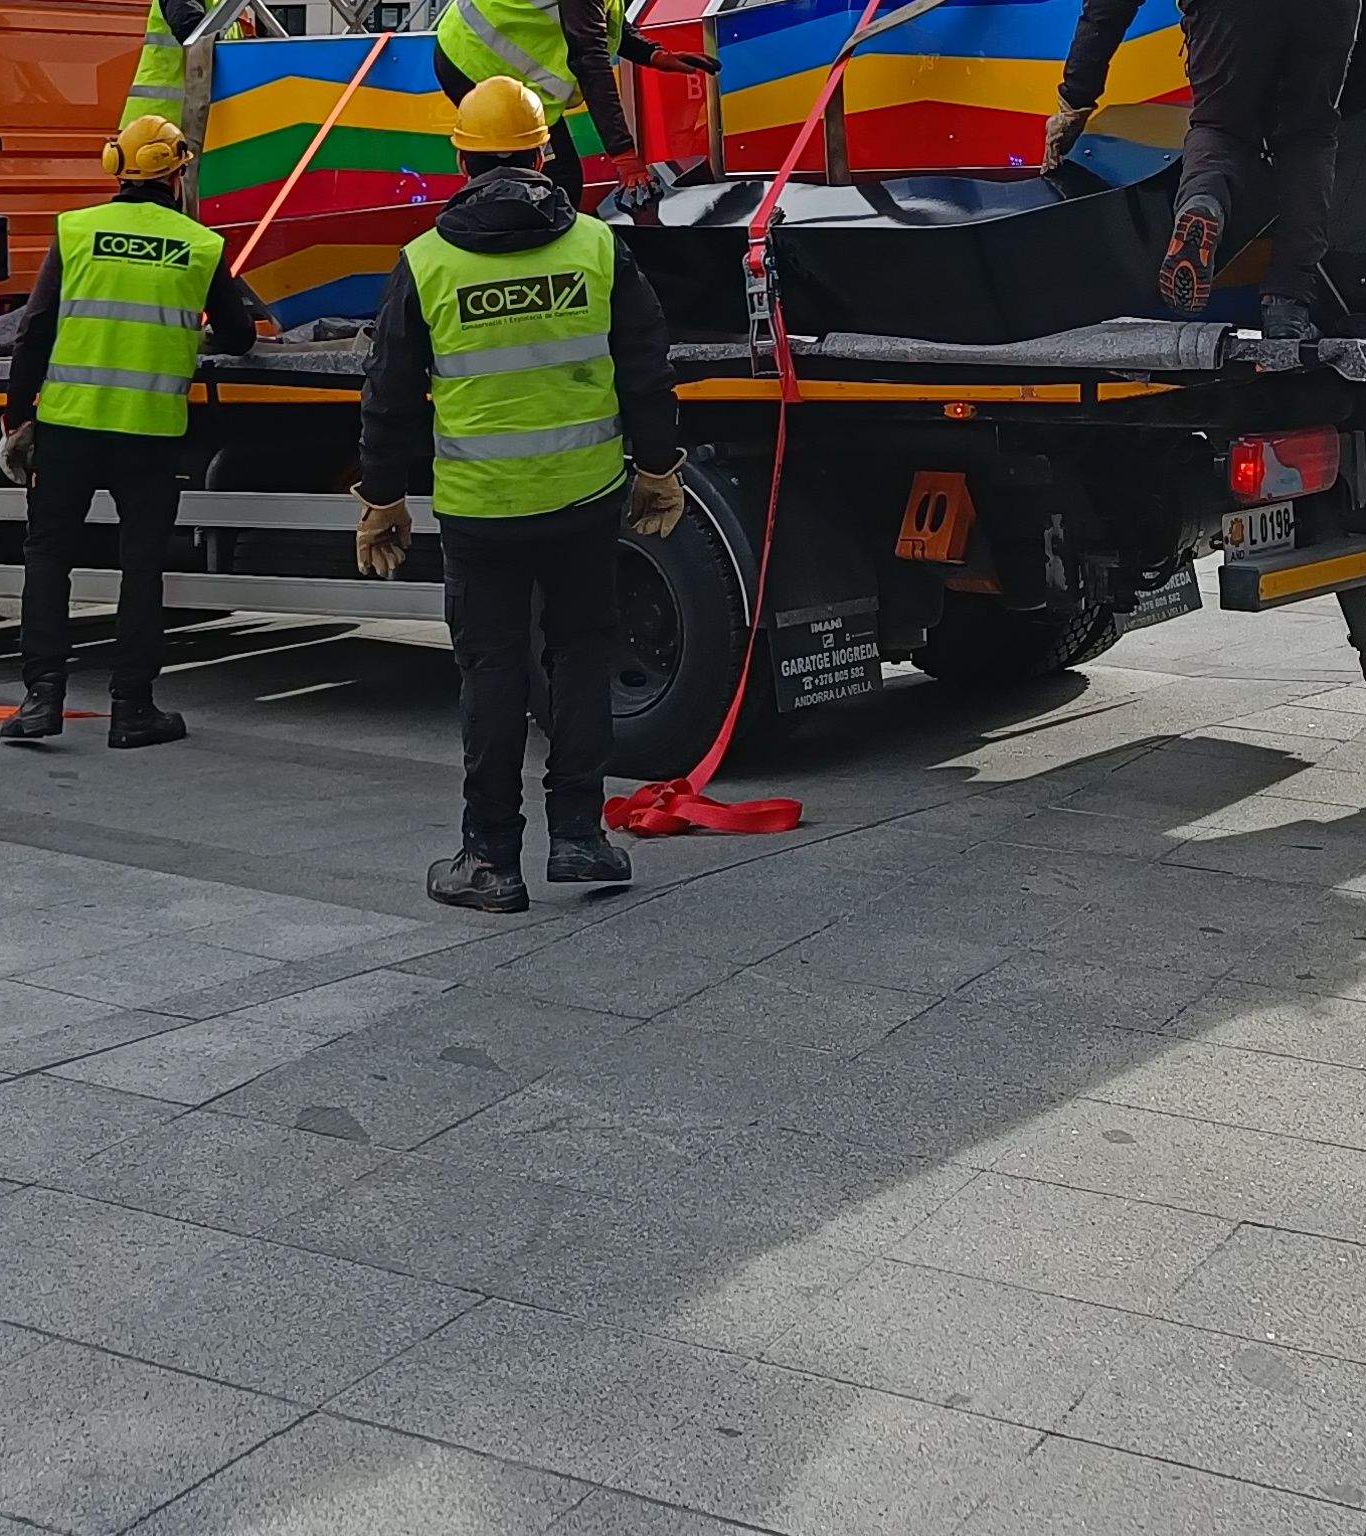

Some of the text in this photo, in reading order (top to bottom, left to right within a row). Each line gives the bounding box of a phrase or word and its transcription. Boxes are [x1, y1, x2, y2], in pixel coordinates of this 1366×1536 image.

[99, 235, 158, 258] COEX
[466, 283, 544, 315] COEX
[781, 642, 880, 677] GARATGE NOGREDA
[794, 680, 873, 708] ANDORRA LA VELLA
